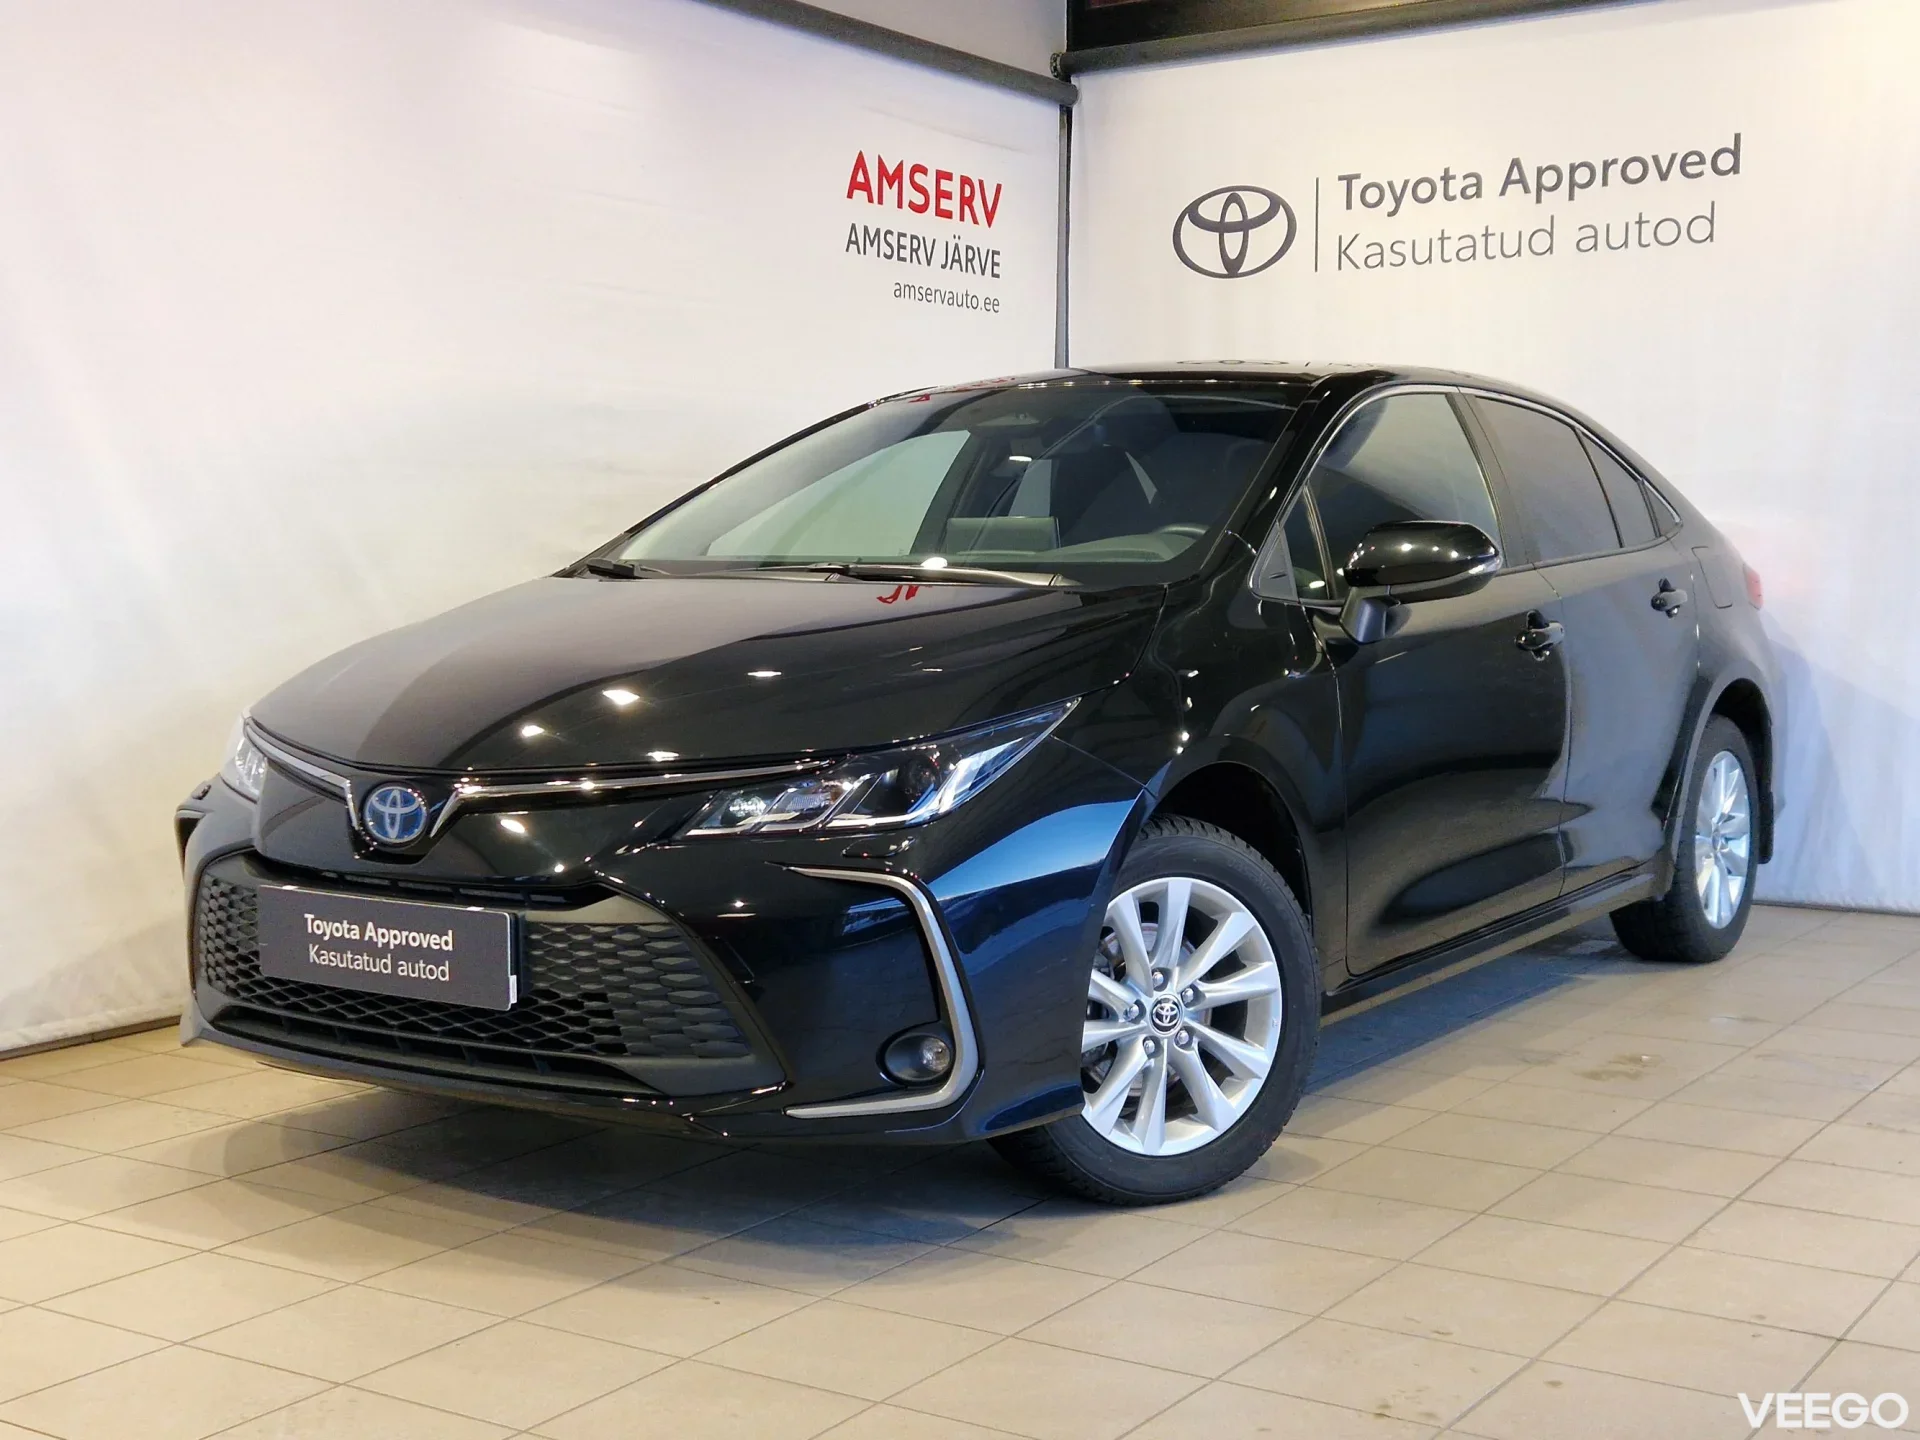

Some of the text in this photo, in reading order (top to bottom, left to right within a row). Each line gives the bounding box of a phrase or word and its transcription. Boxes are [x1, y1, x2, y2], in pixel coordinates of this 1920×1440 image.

[847, 150, 1002, 228] AMSERV
[1338, 133, 1742, 217] Toyota Approved
[845, 222, 1001, 278] AMSERV JÄRVE
[1337, 201, 1716, 271] Kasutatud autod
[893, 281, 1000, 313] amservauto.ee
[304, 913, 453, 950] Toyota Approved
[309, 943, 449, 981] Kasutatud autod
